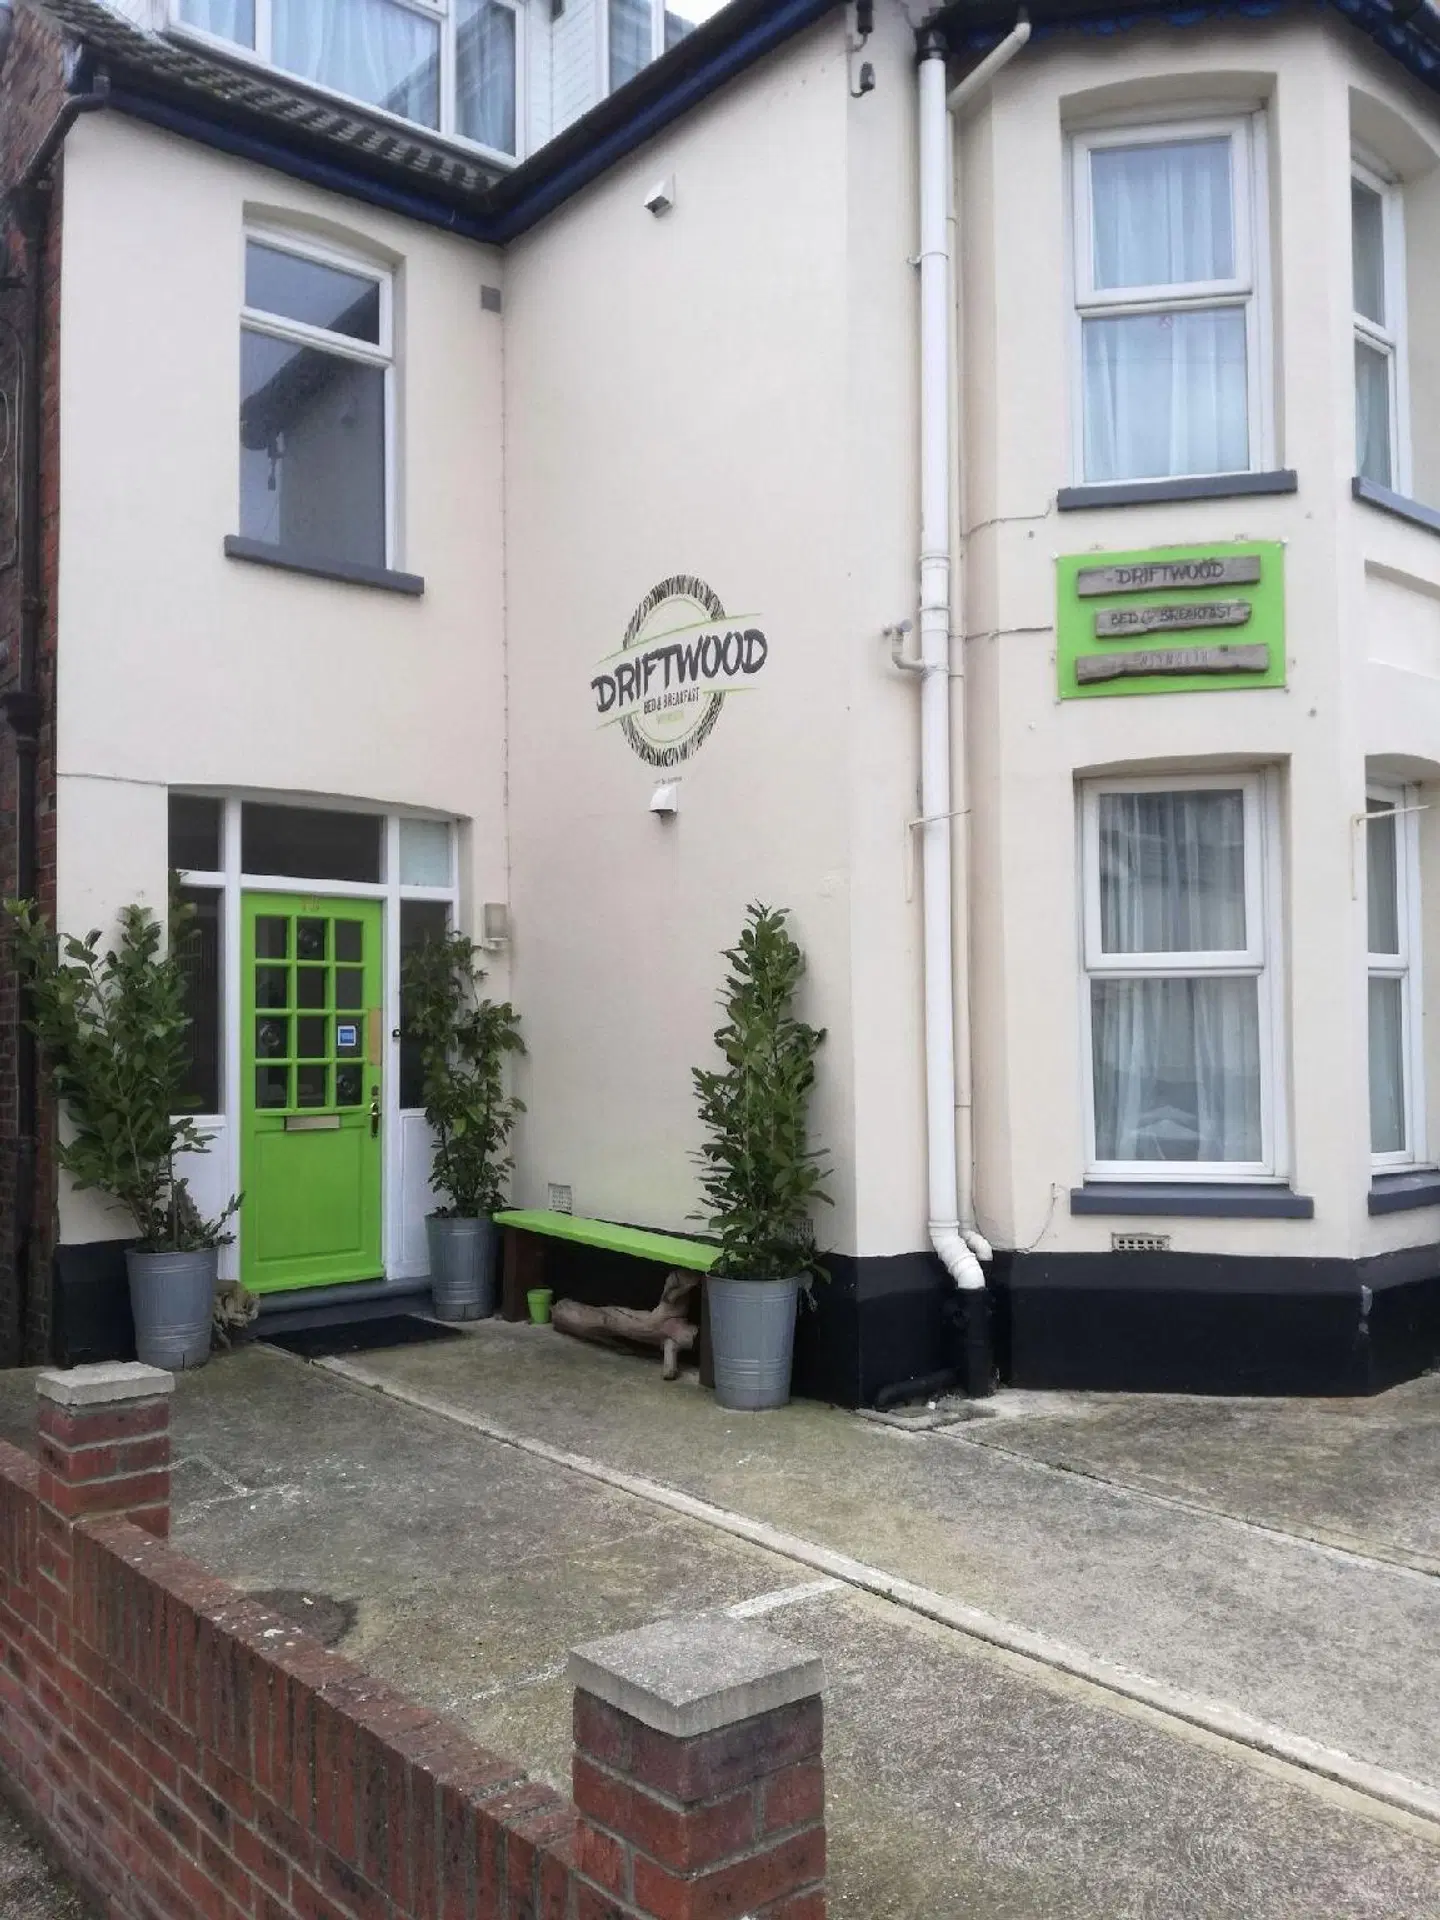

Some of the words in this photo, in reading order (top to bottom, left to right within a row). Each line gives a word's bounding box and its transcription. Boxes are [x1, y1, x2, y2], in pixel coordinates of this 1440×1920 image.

[1115, 560, 1225, 585] DRIFTWOOD
[1111, 612, 1138, 626] BED
[1160, 605, 1231, 622] BREAKFAST
[590, 628, 768, 713] DRIFTWOOD
[644, 698, 656, 715] BED
[656, 696, 662, 711] &
[663, 687, 700, 708] BREAKFAST
